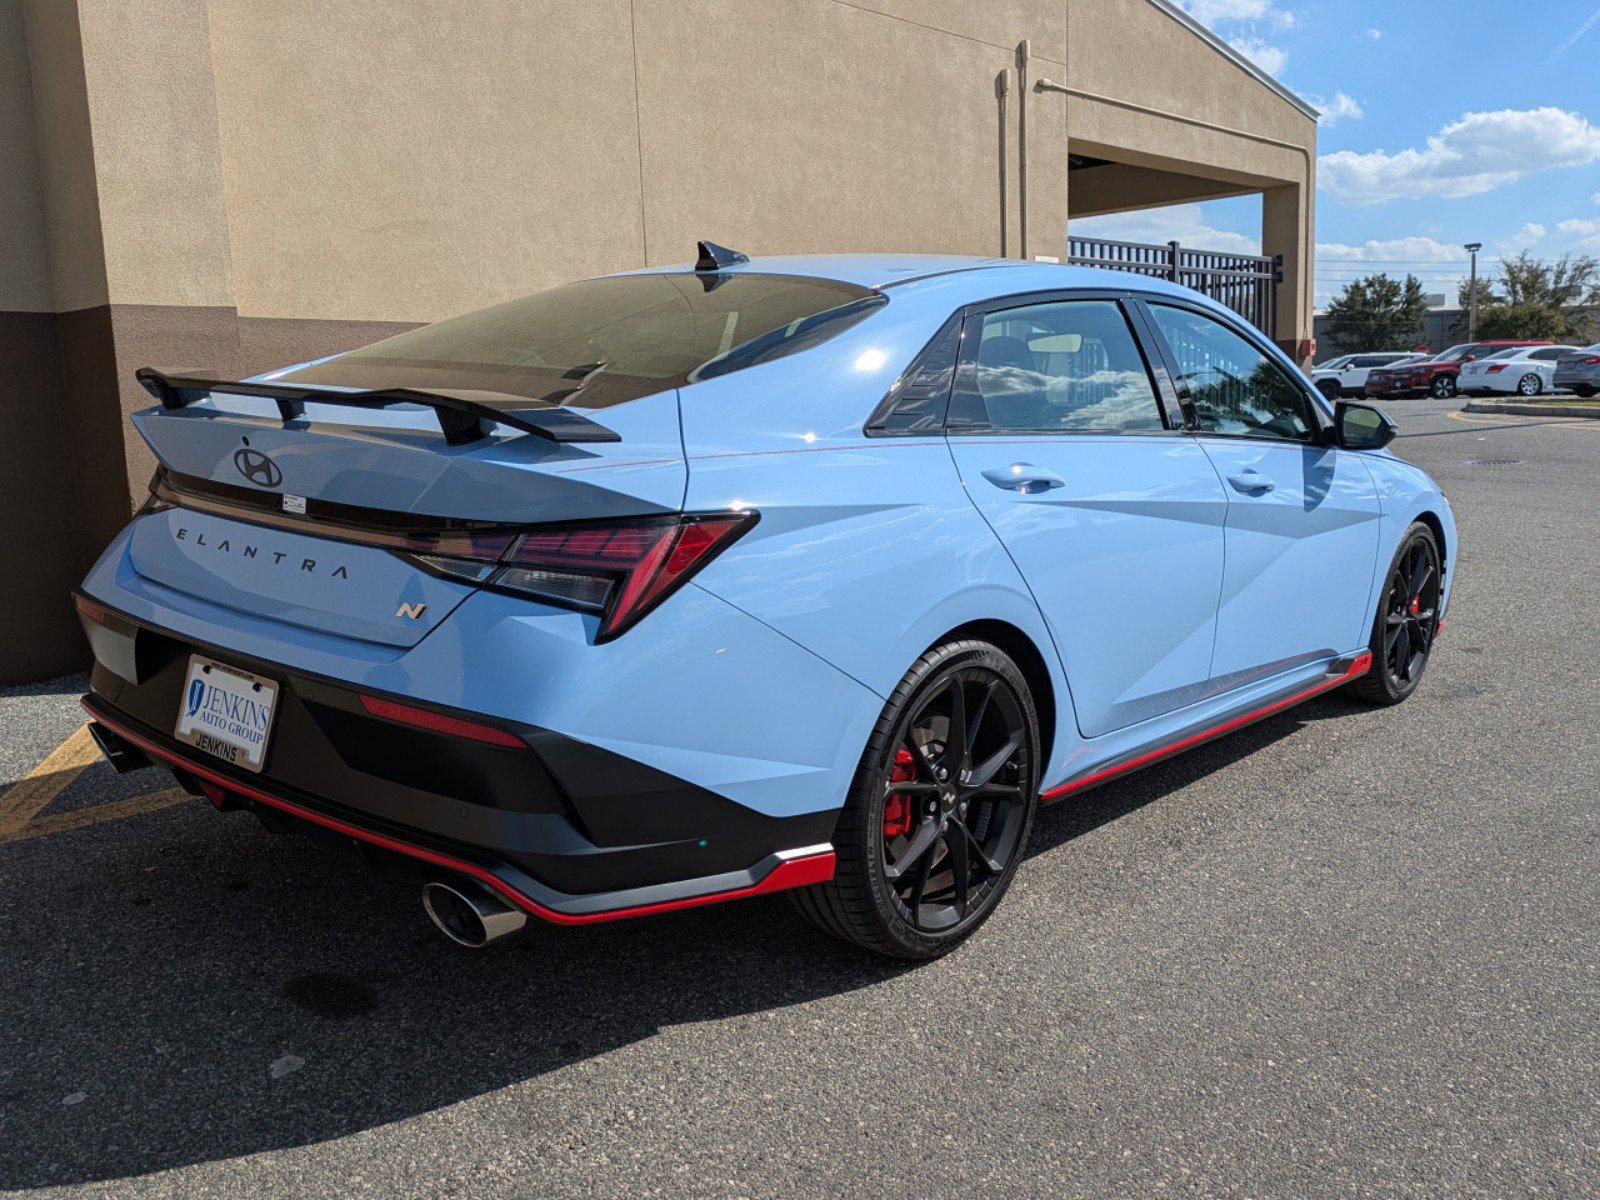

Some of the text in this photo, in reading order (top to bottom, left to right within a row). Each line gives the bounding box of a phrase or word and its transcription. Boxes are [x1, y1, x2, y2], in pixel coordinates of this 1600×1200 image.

[176, 528, 347, 580] ELANTRA
[395, 602, 427, 620] N
[203, 686, 270, 731] JENKINS
[199, 711, 264, 744] AUTO GROUP
[195, 735, 238, 761] JENKINS
